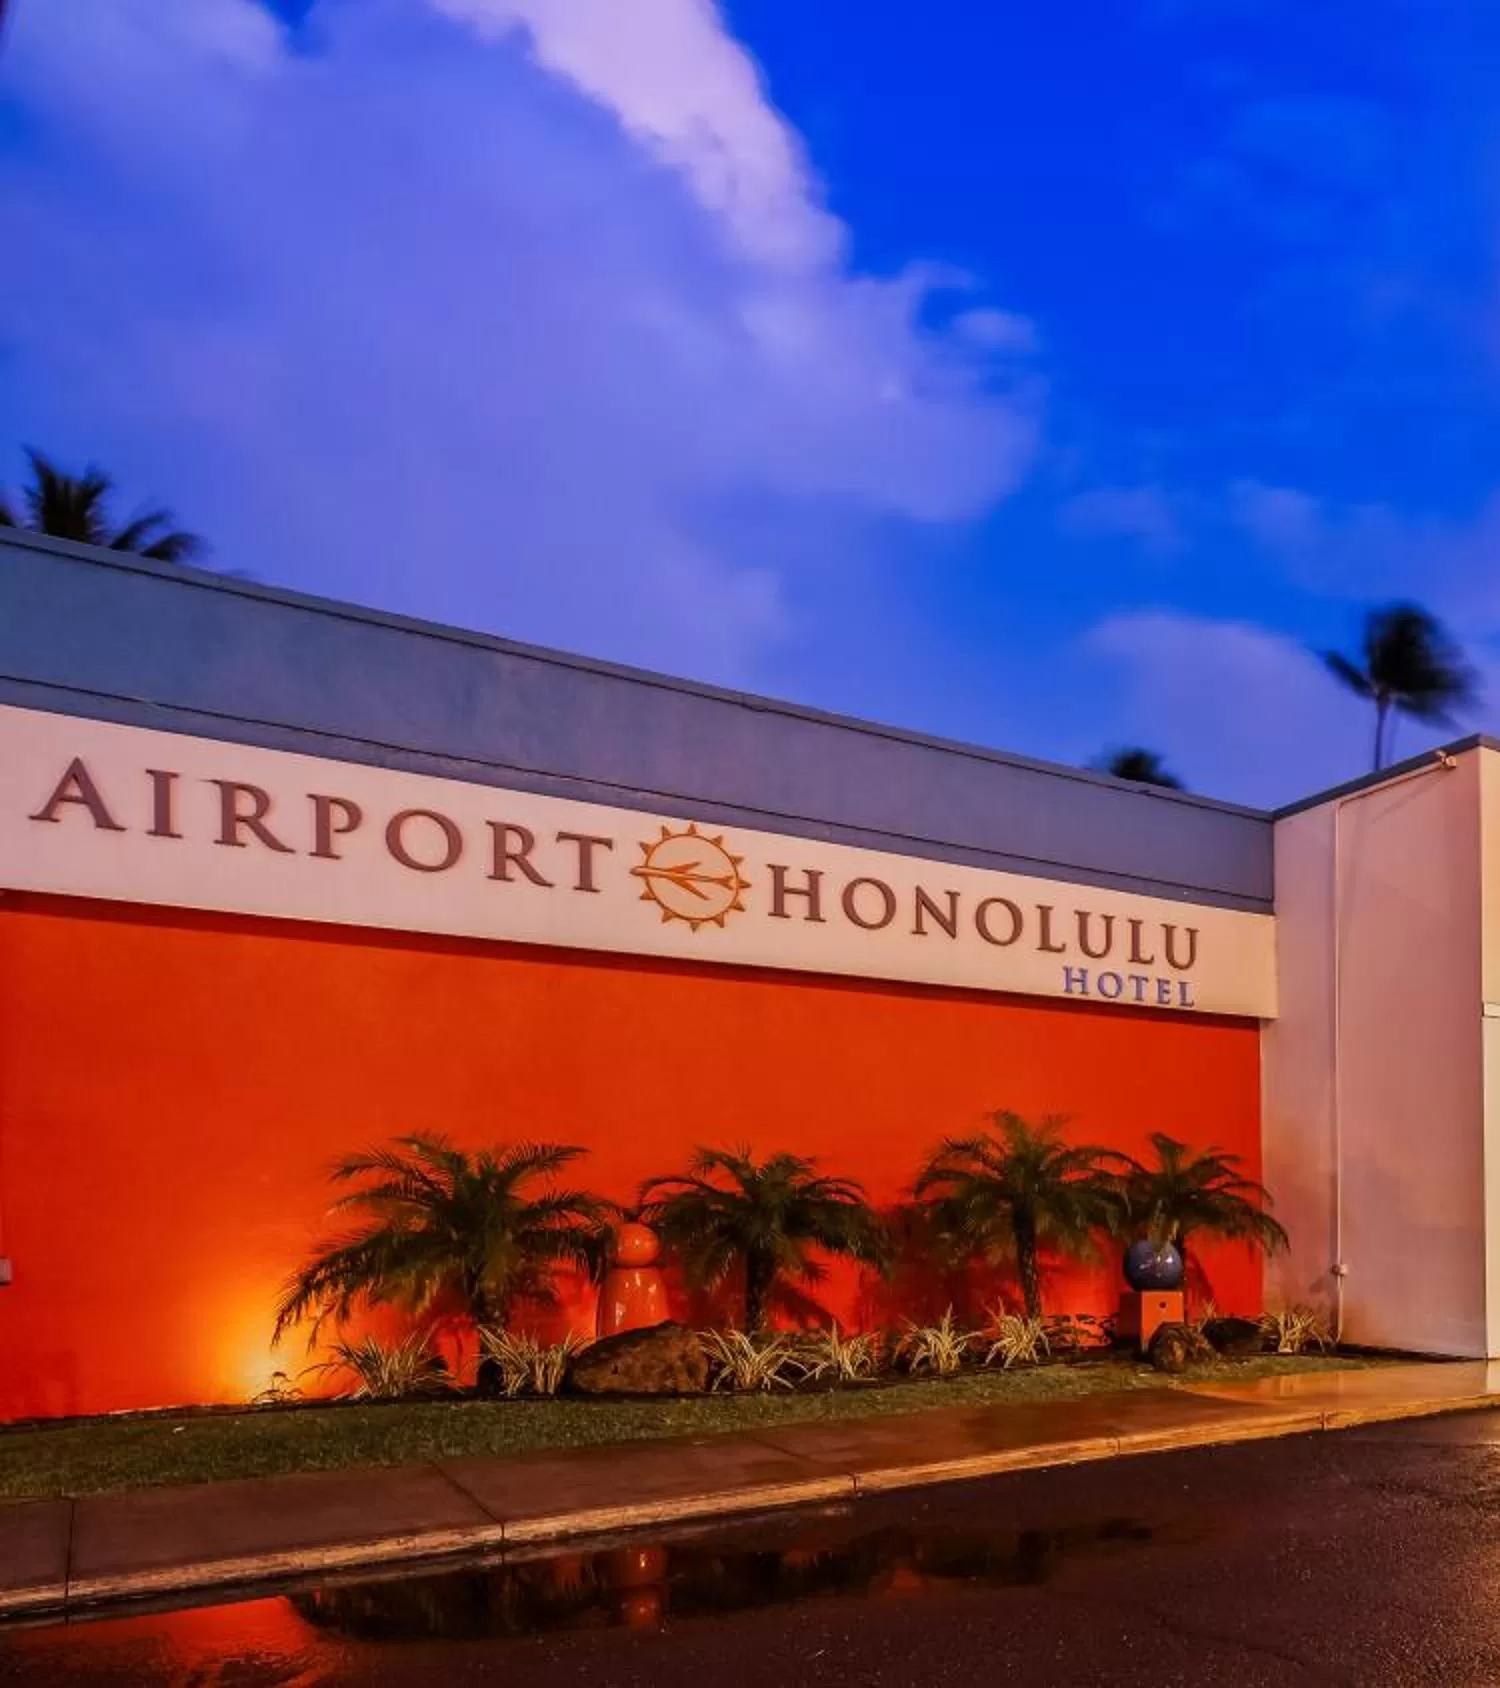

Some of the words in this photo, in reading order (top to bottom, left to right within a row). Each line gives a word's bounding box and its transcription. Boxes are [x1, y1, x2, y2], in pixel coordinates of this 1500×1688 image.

[28, 756, 613, 892] AIRPORT
[766, 863, 1200, 970] HONOLULU
[1062, 966, 1195, 1008] HOTEL
